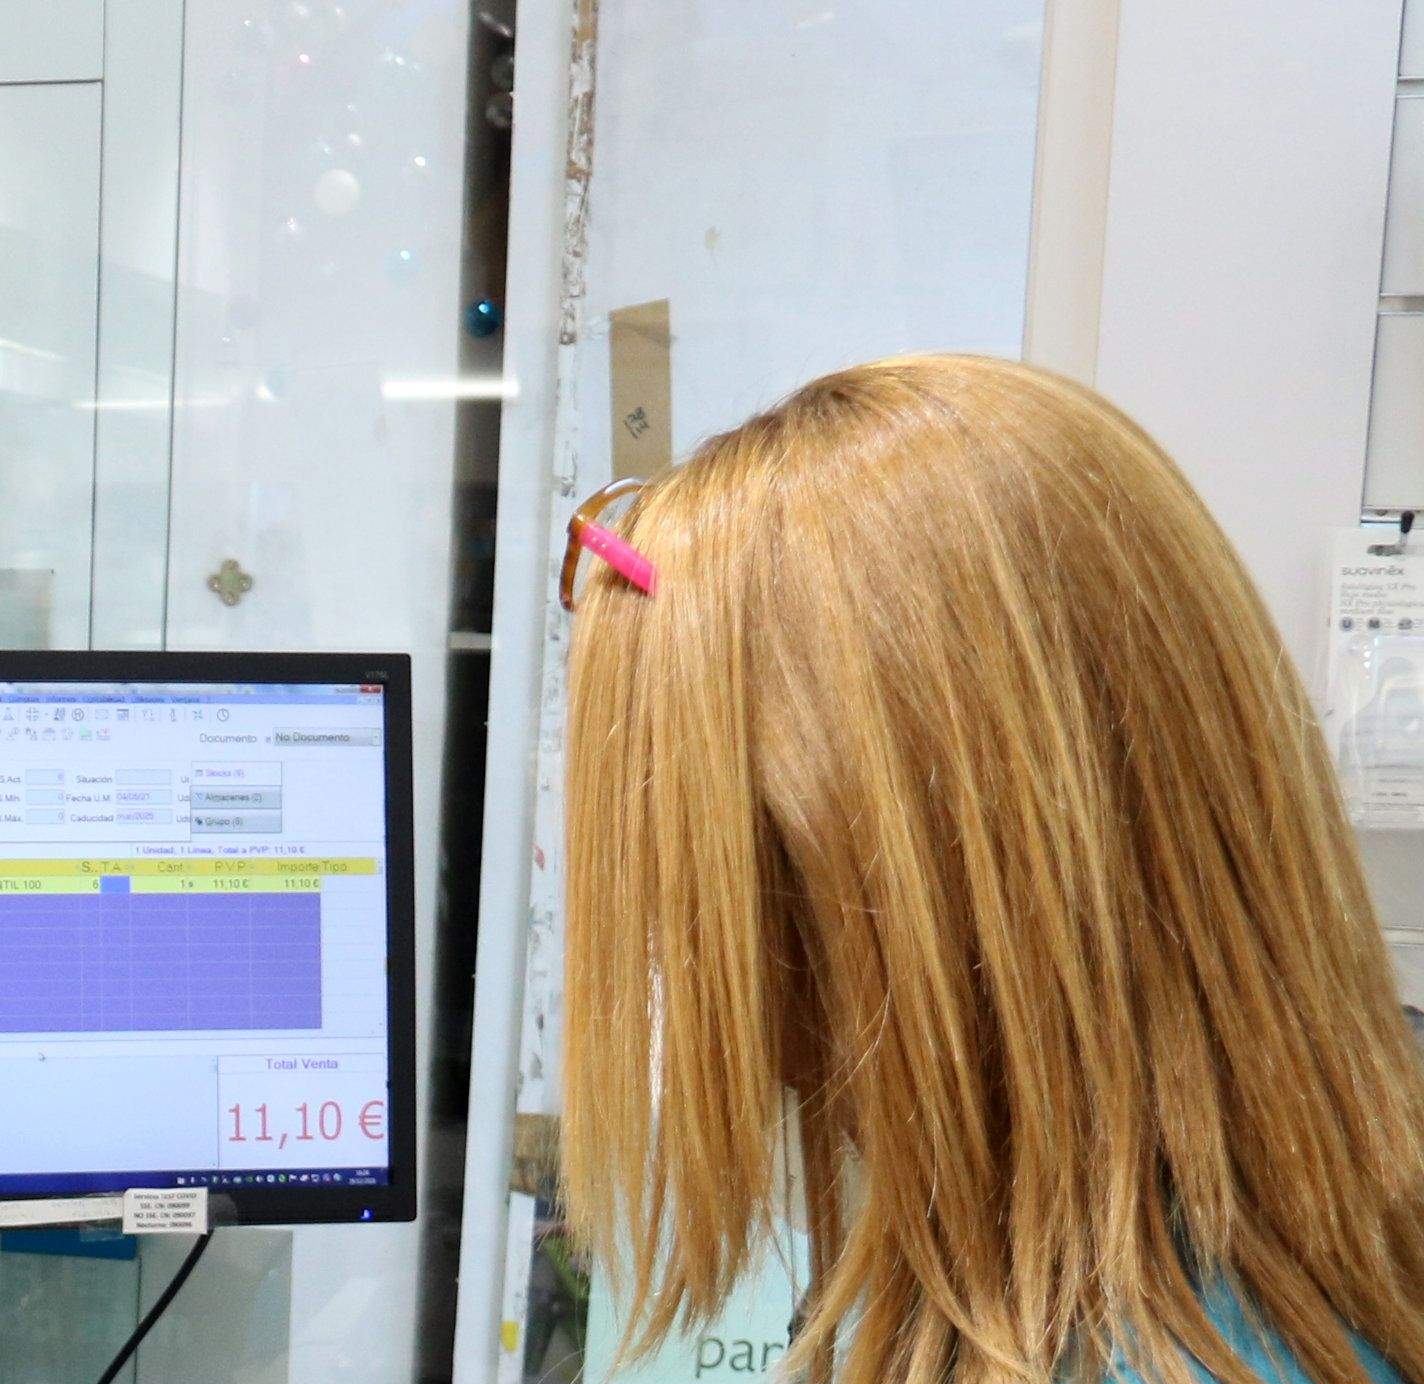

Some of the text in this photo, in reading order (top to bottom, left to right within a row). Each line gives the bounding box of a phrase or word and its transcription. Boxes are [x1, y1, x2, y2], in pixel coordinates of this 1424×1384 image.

[199, 732, 257, 744] Documento
[275, 732, 350, 743] No Documento
[277, 860, 320, 875] Importe
[322, 860, 348, 875] Tipo
[23, 879, 42, 890] 100
[213, 878, 240, 890] 11,10
[265, 1057, 339, 1070] Total Venta
[228, 1099, 385, 1150] 11,10 €
